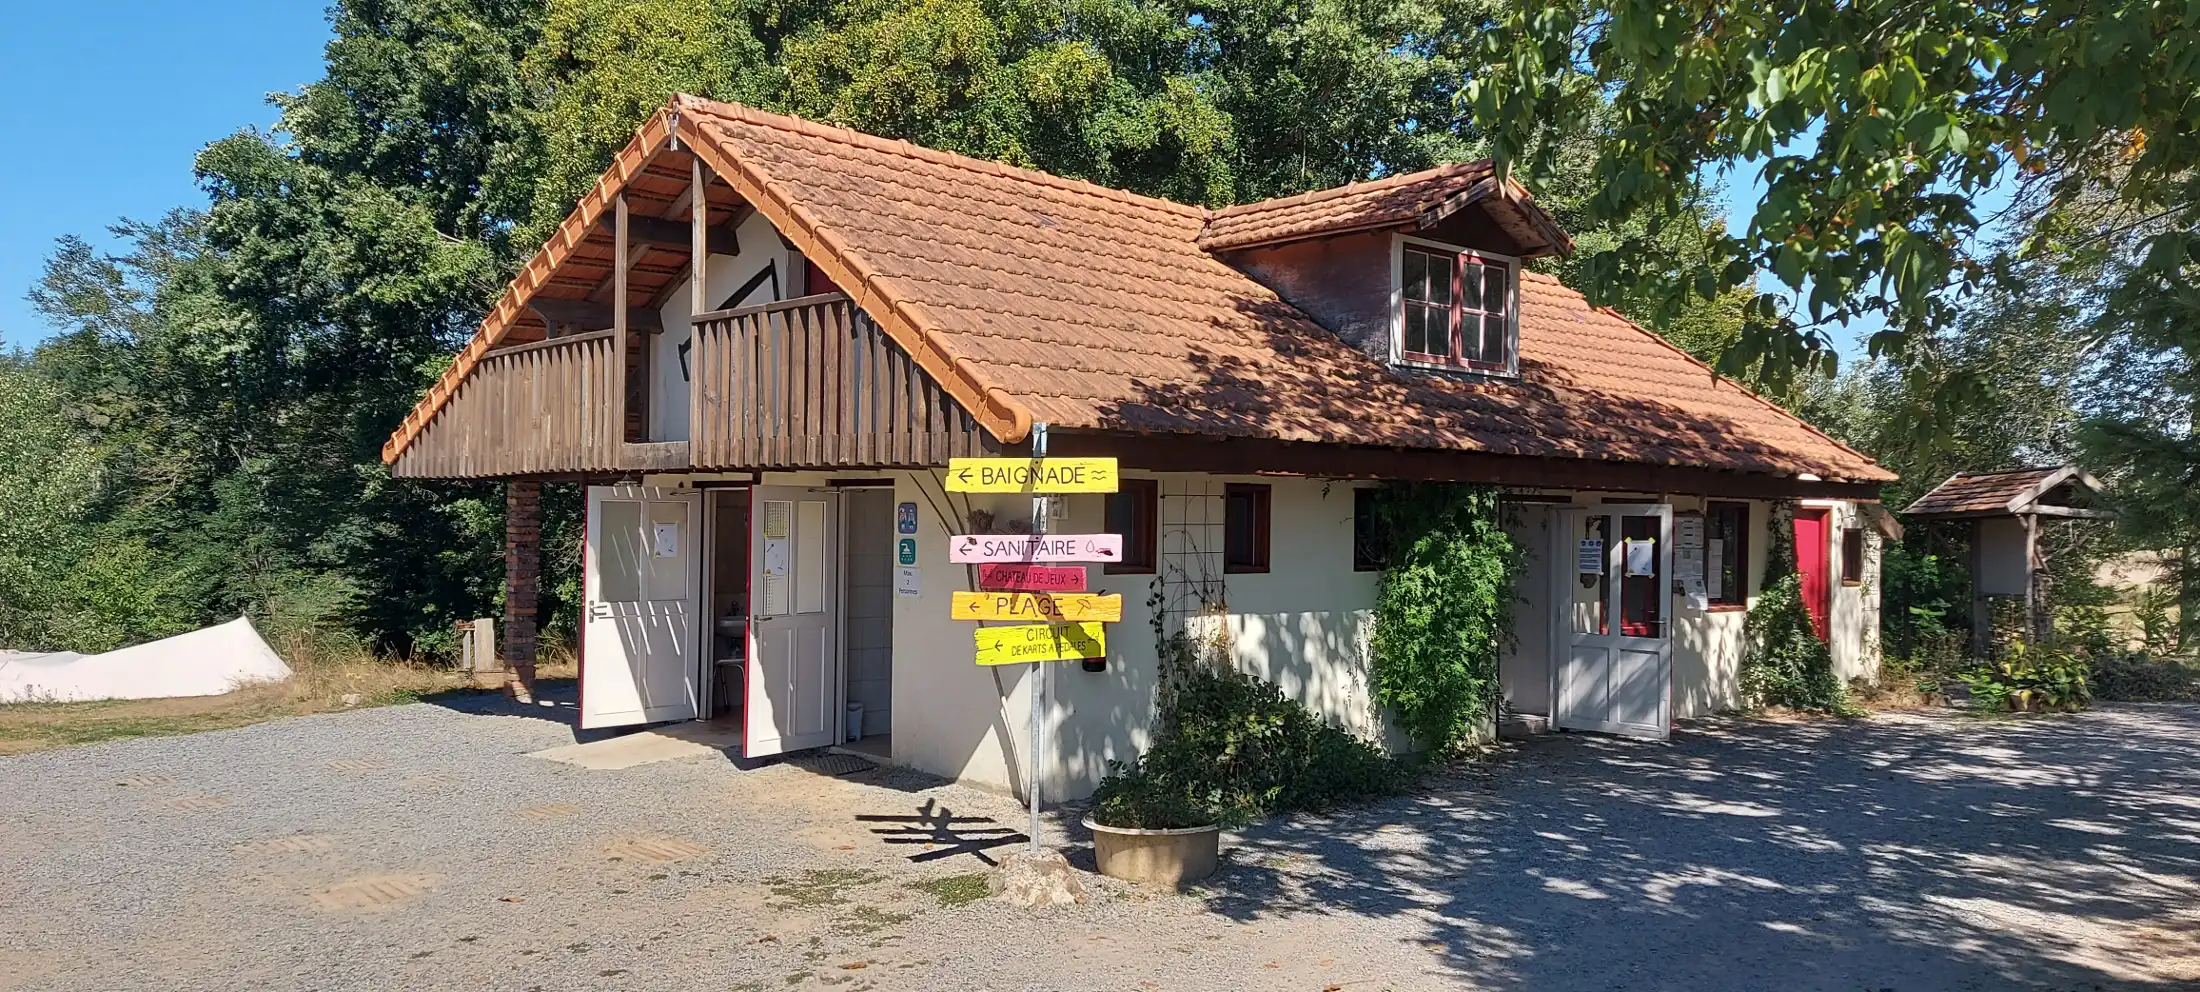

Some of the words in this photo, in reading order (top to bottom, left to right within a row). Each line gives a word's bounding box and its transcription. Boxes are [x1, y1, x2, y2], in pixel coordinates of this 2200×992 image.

[981, 466, 1086, 485] BAIGNADE
[983, 540, 1076, 556] SANITAIRE
[995, 569, 1031, 584] CHATEAU
[1033, 572, 1043, 583] DE
[1045, 573, 1066, 585] JEUX
[996, 597, 1064, 616] PLAGE
[1026, 626, 1070, 642] CIRCUIT
[1011, 645, 1021, 656] DE
[1022, 643, 1047, 655] KARTS
